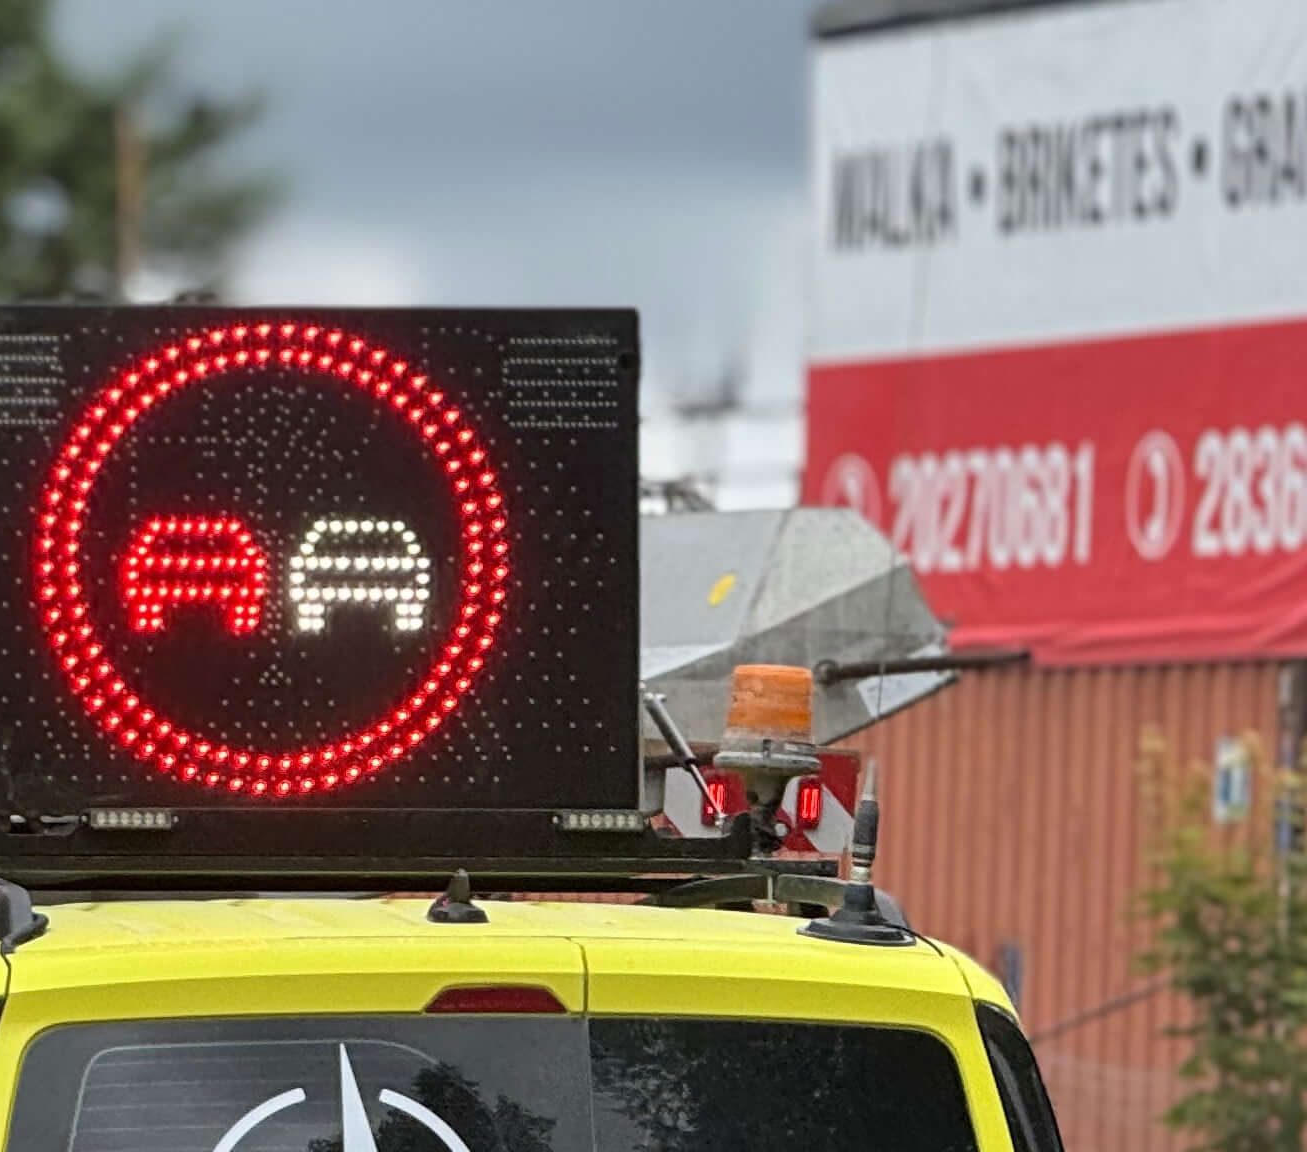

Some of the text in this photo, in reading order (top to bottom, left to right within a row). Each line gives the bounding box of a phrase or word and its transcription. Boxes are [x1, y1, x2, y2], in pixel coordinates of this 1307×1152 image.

[998, 106, 1178, 236] BRIKETES
[1222, 90, 1307, 210] GRA
[890, 441, 1094, 571] 20270681
